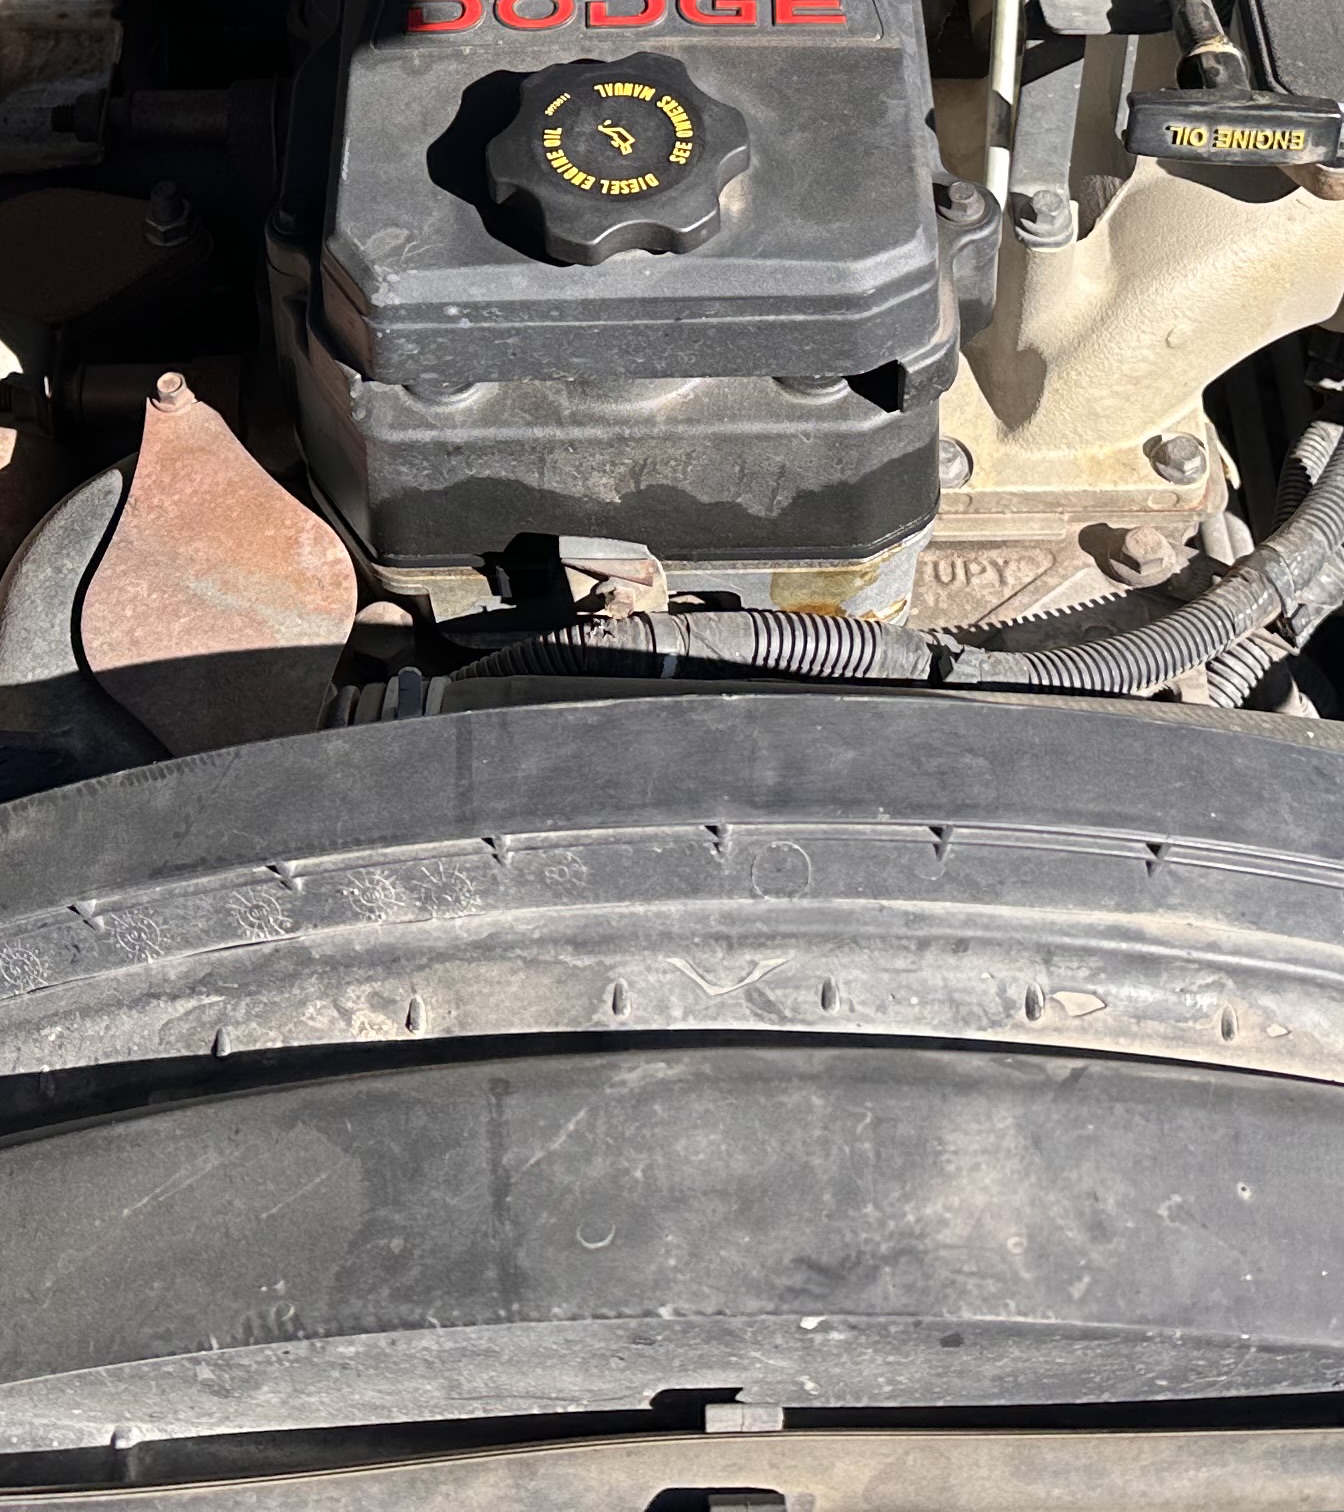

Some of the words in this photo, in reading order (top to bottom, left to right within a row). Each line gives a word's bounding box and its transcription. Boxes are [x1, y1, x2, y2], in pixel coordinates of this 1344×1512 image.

[593, 82, 656, 102] MANUAL
[656, 95, 694, 138] OWNERS
[543, 127, 563, 148] OIL
[1168, 124, 1209, 148] OIL
[1215, 126, 1306, 151] ENGINE
[668, 140, 693, 165] SEE
[545, 149, 597, 190] ENGINE
[599, 173, 660, 195] DIESEL
